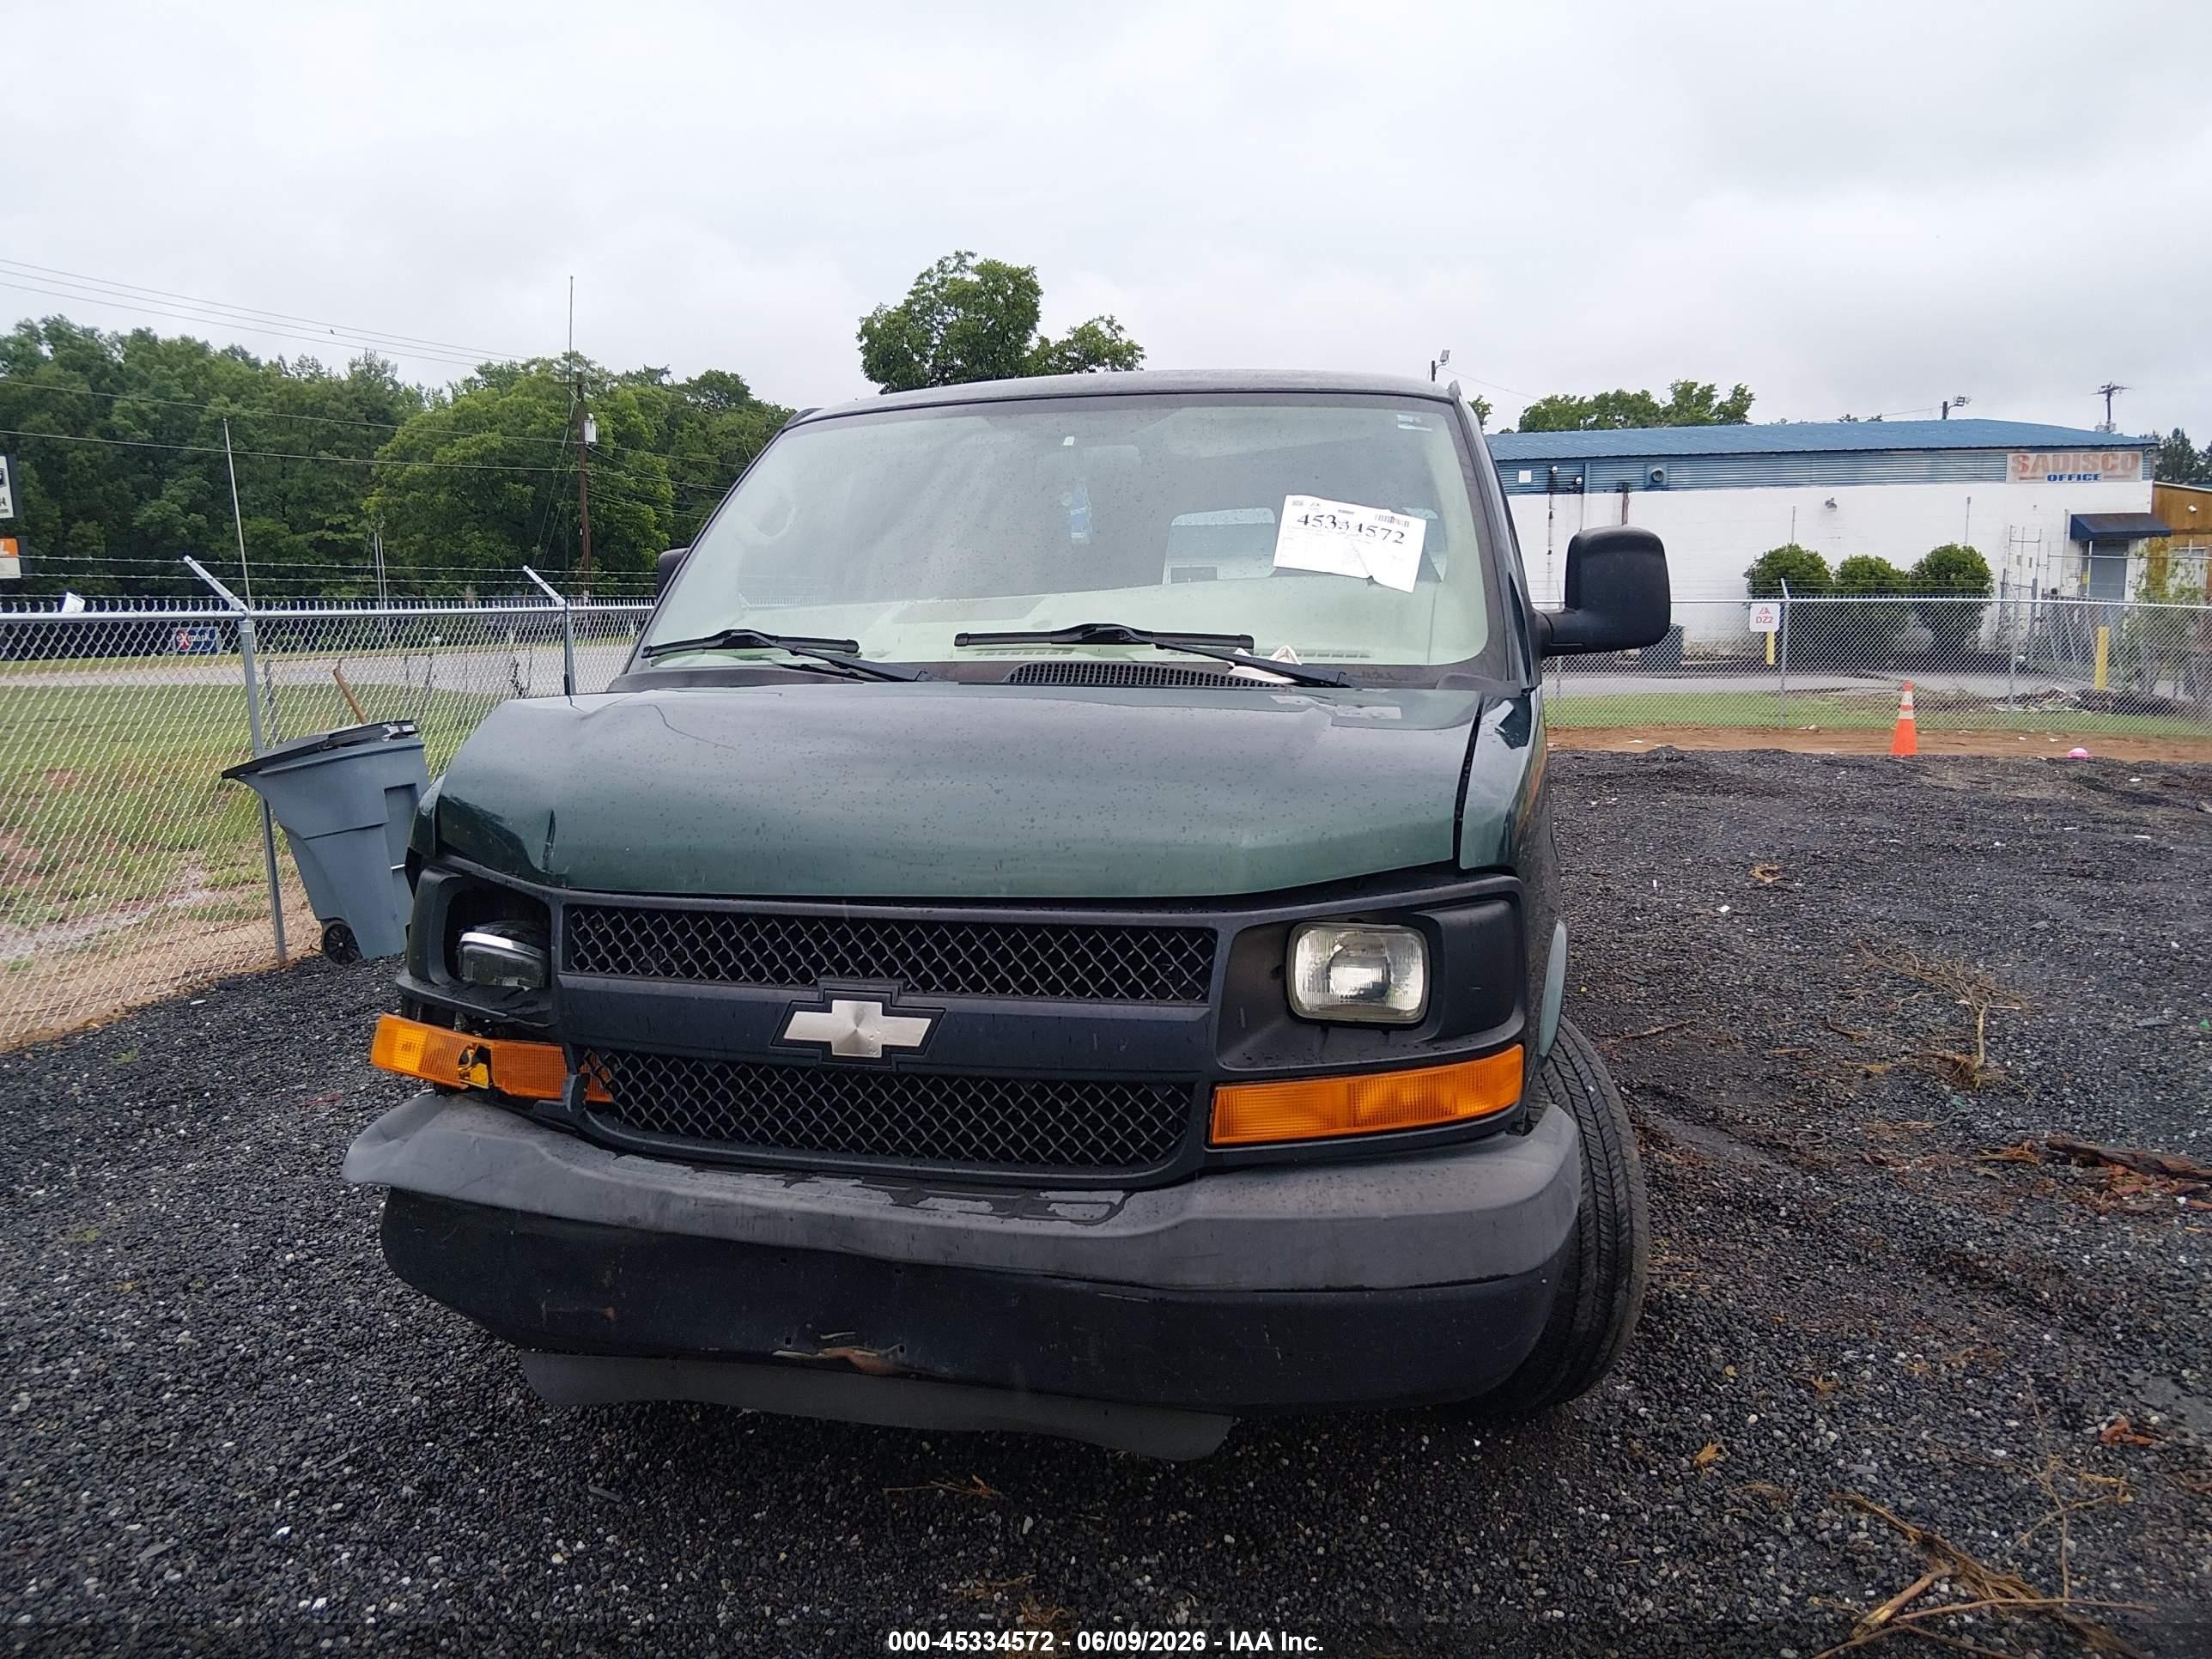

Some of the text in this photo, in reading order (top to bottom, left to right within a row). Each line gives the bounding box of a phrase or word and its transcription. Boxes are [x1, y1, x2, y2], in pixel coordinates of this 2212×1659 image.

[2012, 453, 2138, 473] SADISCO
[2046, 473, 2102, 482] OFFICE
[1755, 616, 1773, 624] DZ2
